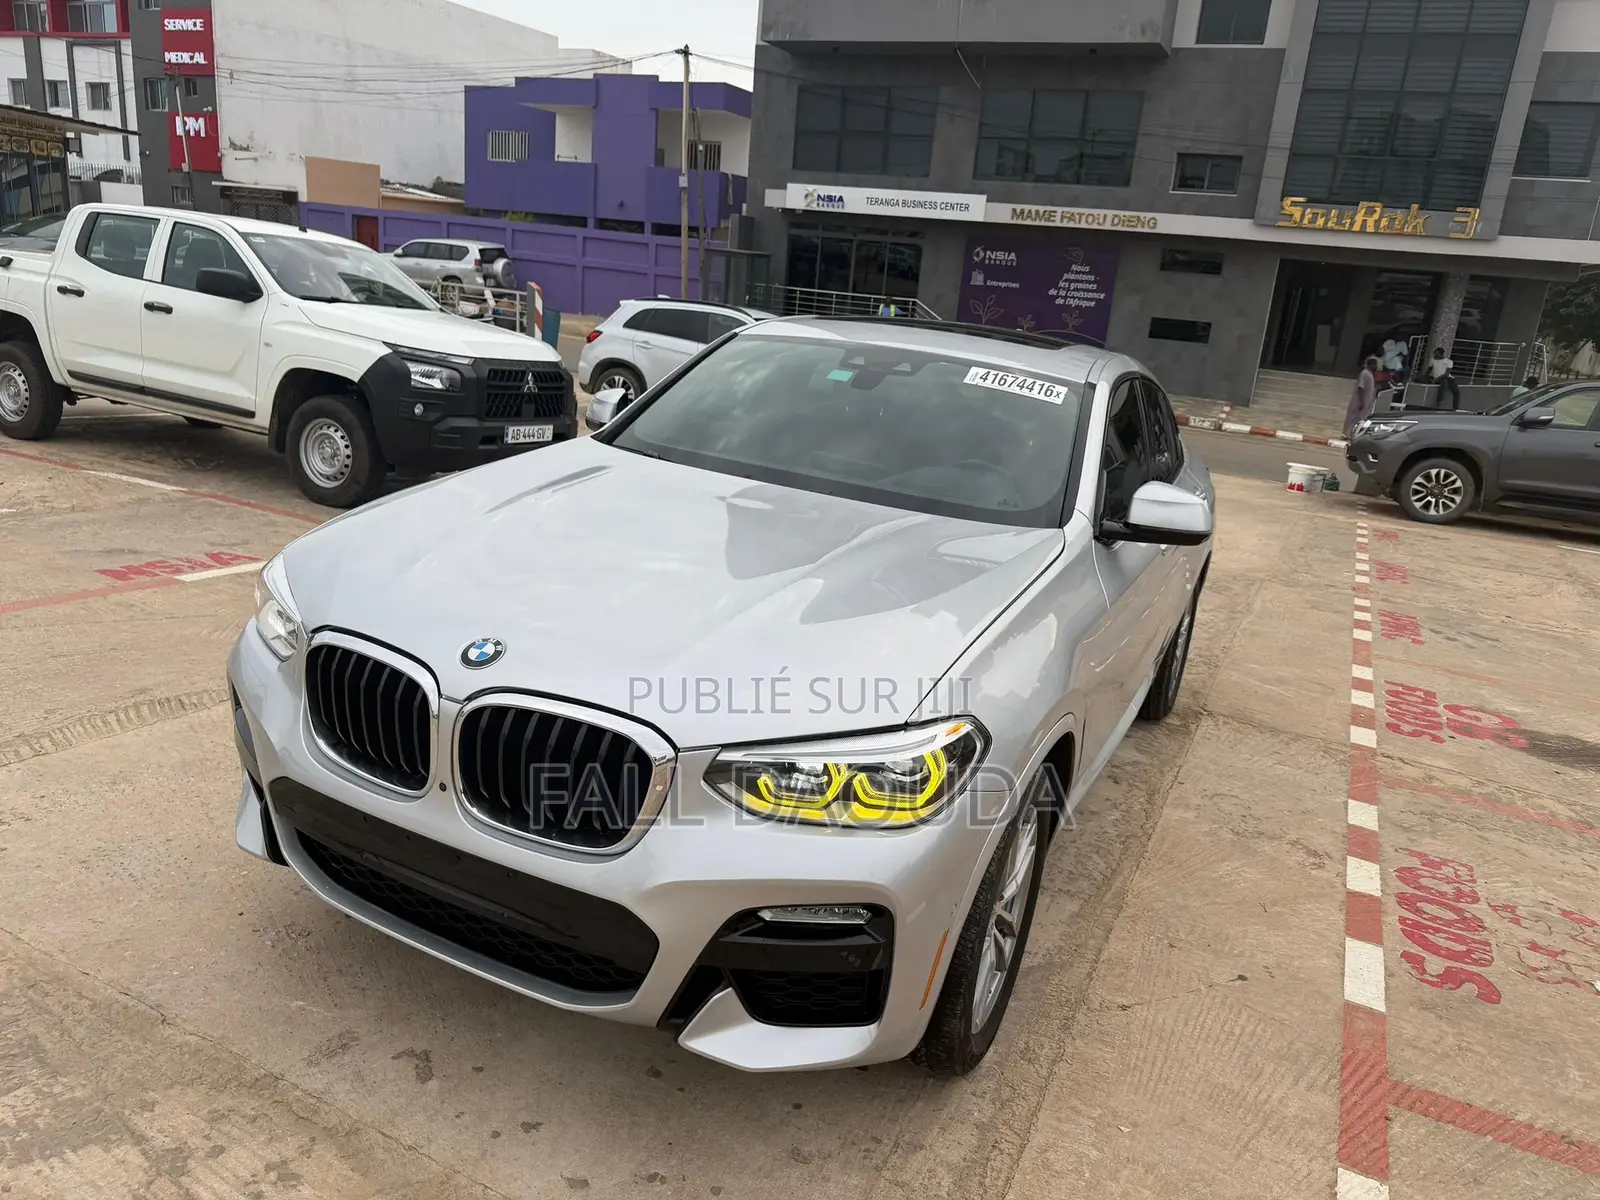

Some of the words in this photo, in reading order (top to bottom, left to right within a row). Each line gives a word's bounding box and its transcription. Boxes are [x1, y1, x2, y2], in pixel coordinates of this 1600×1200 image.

[163, 18, 205, 31] SERVICE
[164, 51, 208, 64] MEDICAL
[816, 193, 845, 204] NSIA
[865, 196, 900, 208] TERANGA
[901, 200, 938, 210] BUSINESS
[939, 202, 970, 213] CENTER
[1010, 207, 1058, 224] MAME
[1060, 210, 1108, 227] FATOU
[1449, 206, 1480, 239] 3
[985, 250, 1017, 261] NSIA
[1071, 264, 1090, 272] Nous
[1062, 272, 1095, 281] plantons
[986, 279, 1020, 289] Entreprises
[1058, 280, 1069, 288] les
[1070, 282, 1097, 290] graines
[1048, 288, 1058, 296] de
[1058, 288, 1067, 297] la
[1067, 290, 1106, 299] croissance
[1055, 297, 1065, 305] de
[1383, 680, 1446, 744] FOODS
[1393, 847, 1502, 1004] FOODS
